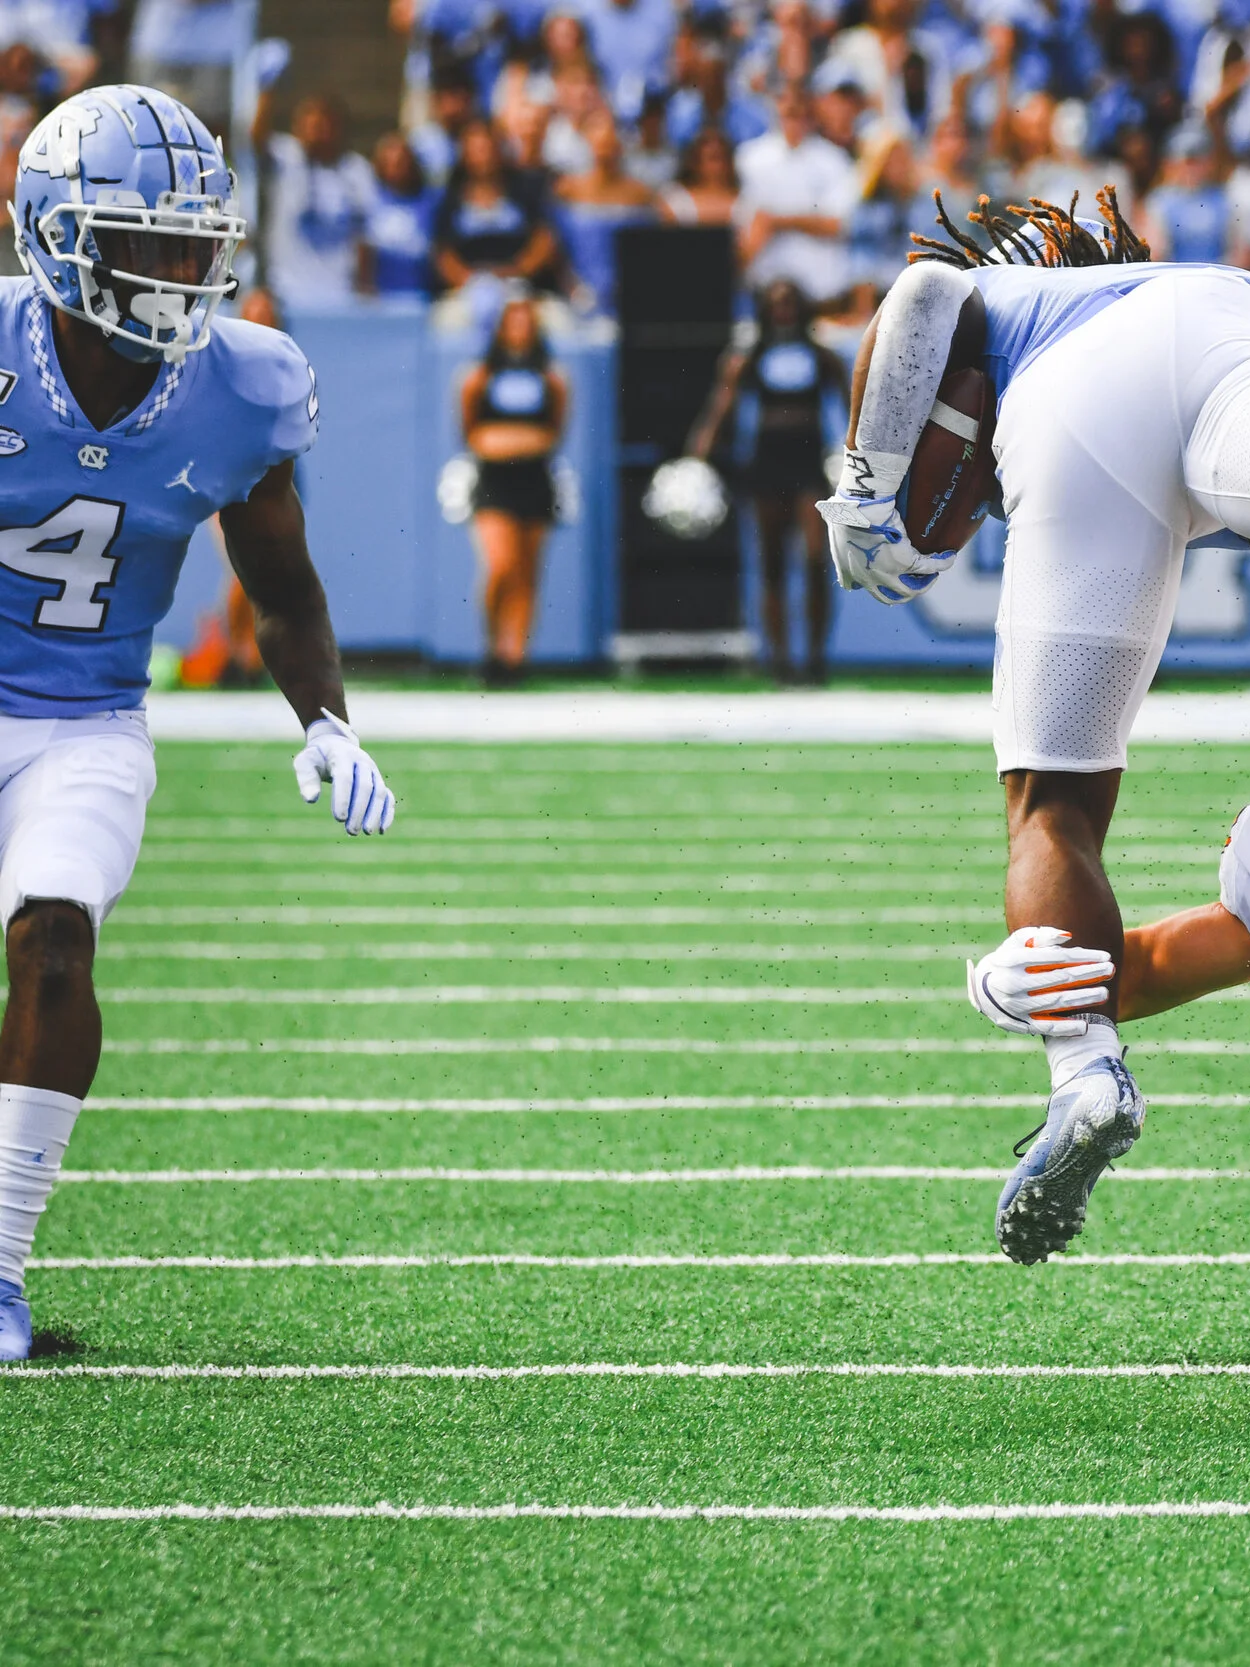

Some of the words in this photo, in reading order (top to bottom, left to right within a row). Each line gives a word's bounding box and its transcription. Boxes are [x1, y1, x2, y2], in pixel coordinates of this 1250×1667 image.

[922, 501, 946, 537] VAPOR
[944, 464, 962, 500] ELITE
[0, 493, 126, 632] 4
